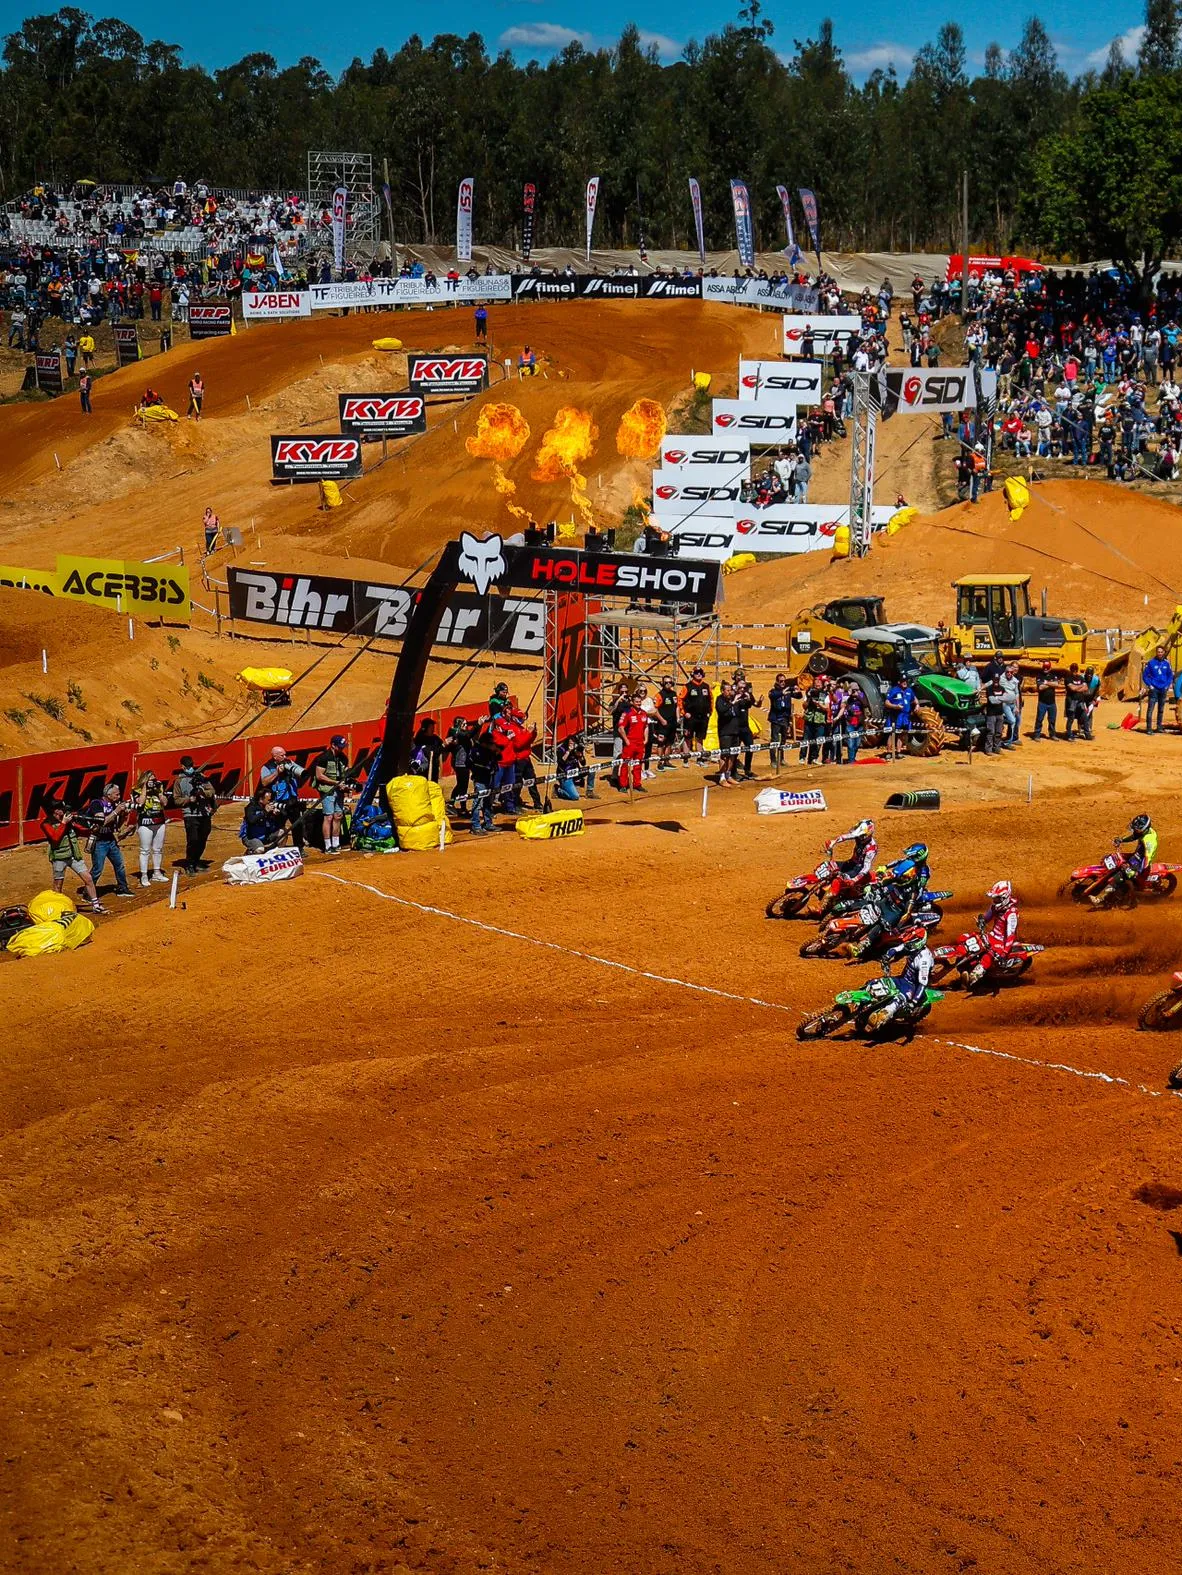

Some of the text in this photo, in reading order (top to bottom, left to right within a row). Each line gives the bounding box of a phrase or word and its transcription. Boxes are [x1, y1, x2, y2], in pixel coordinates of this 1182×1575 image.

[535, 282, 575, 294] fimel
[602, 282, 638, 294] fimel
[665, 282, 700, 296] fimel
[706, 284, 724, 292] ASSA
[190, 307, 230, 319] WRP
[412, 359, 486, 381] KYB
[342, 398, 424, 420] KYB
[275, 440, 359, 462] KYB
[531, 558, 706, 594] HOLESHOT
[236, 571, 350, 628] Bihr
[366, 585, 482, 644] Br
[780, 790, 821, 800] PARTS
[549, 817, 584, 838] THOR
[966, 936, 980, 952] 80
